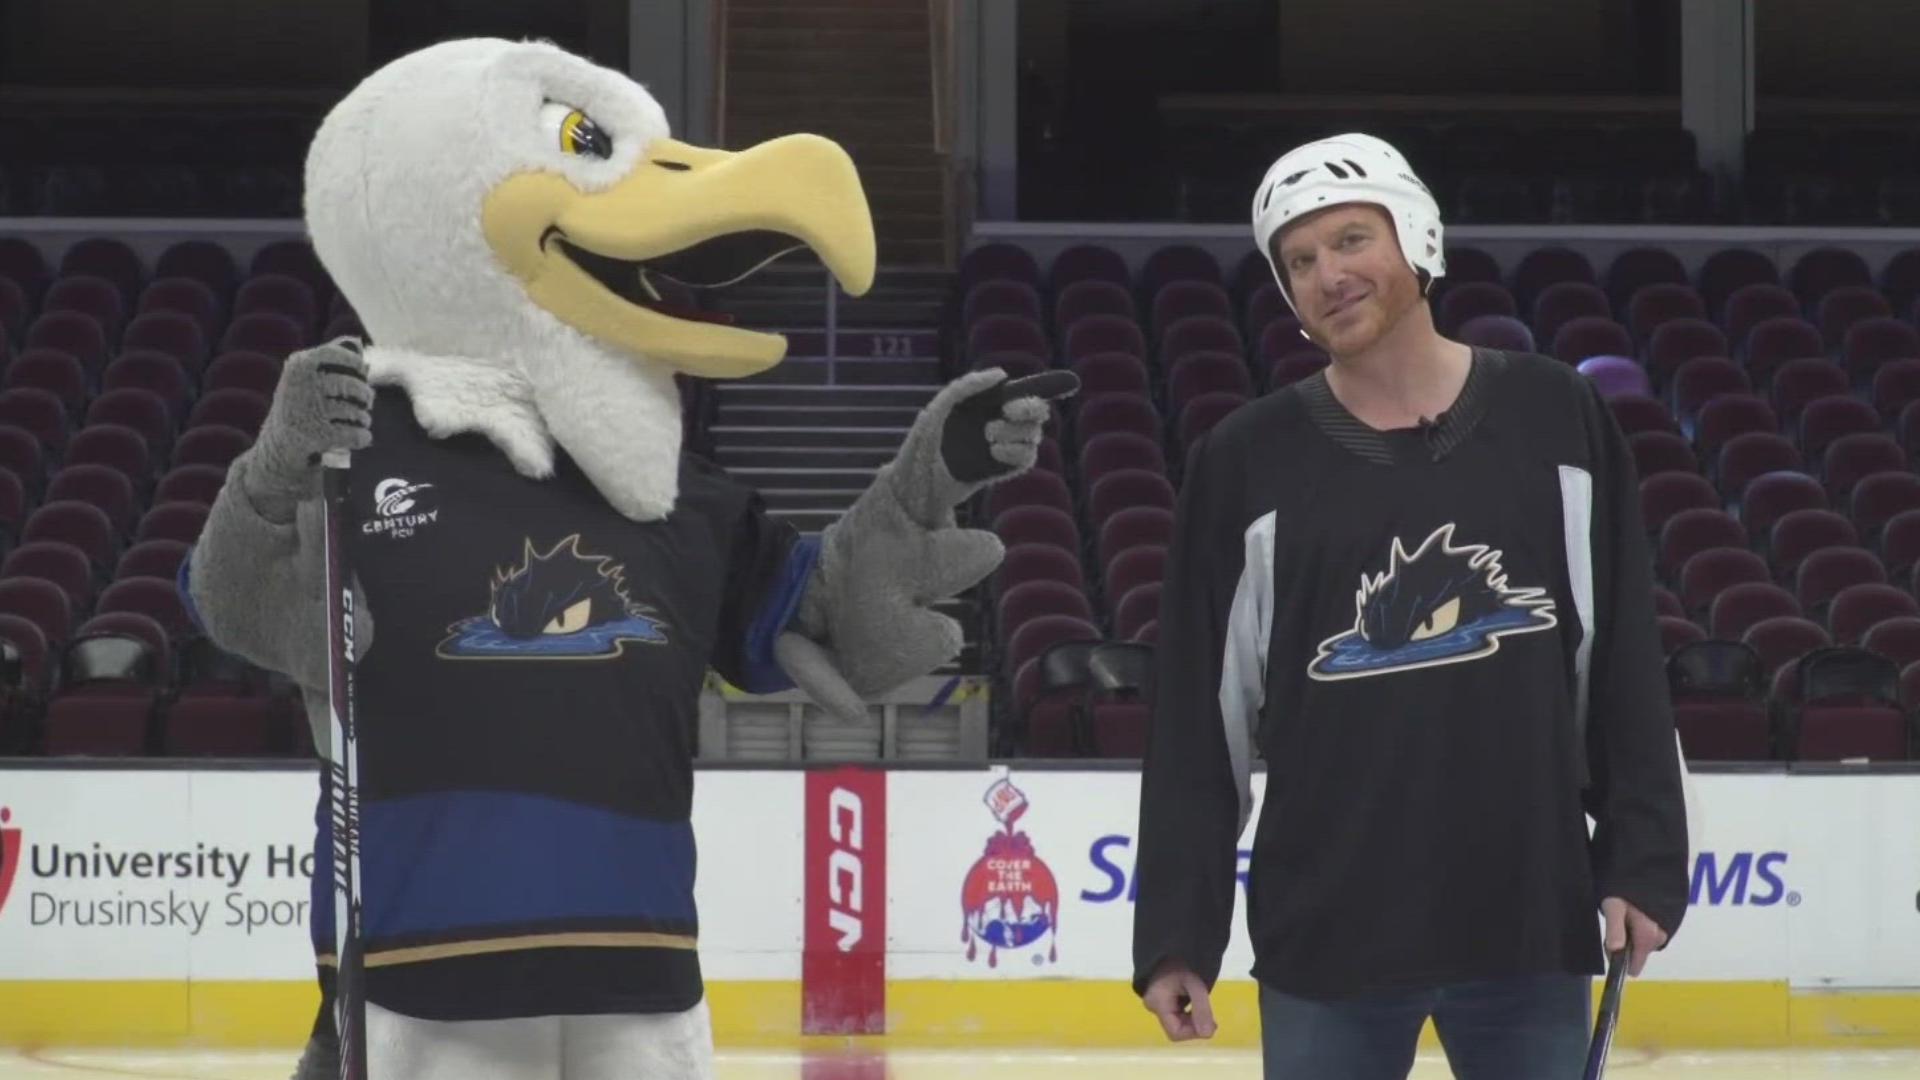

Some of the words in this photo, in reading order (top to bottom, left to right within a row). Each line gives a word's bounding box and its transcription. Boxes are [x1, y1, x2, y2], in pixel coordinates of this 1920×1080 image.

[362, 509, 438, 533] CENTURY
[342, 588, 355, 662] CCM
[31, 842, 250, 888] University
[986, 859, 1032, 870] COVER
[997, 871, 1022, 880] THE
[987, 881, 1032, 891] EARTH
[30, 889, 209, 936] Drusinsky
[225, 892, 309, 936] Spor
